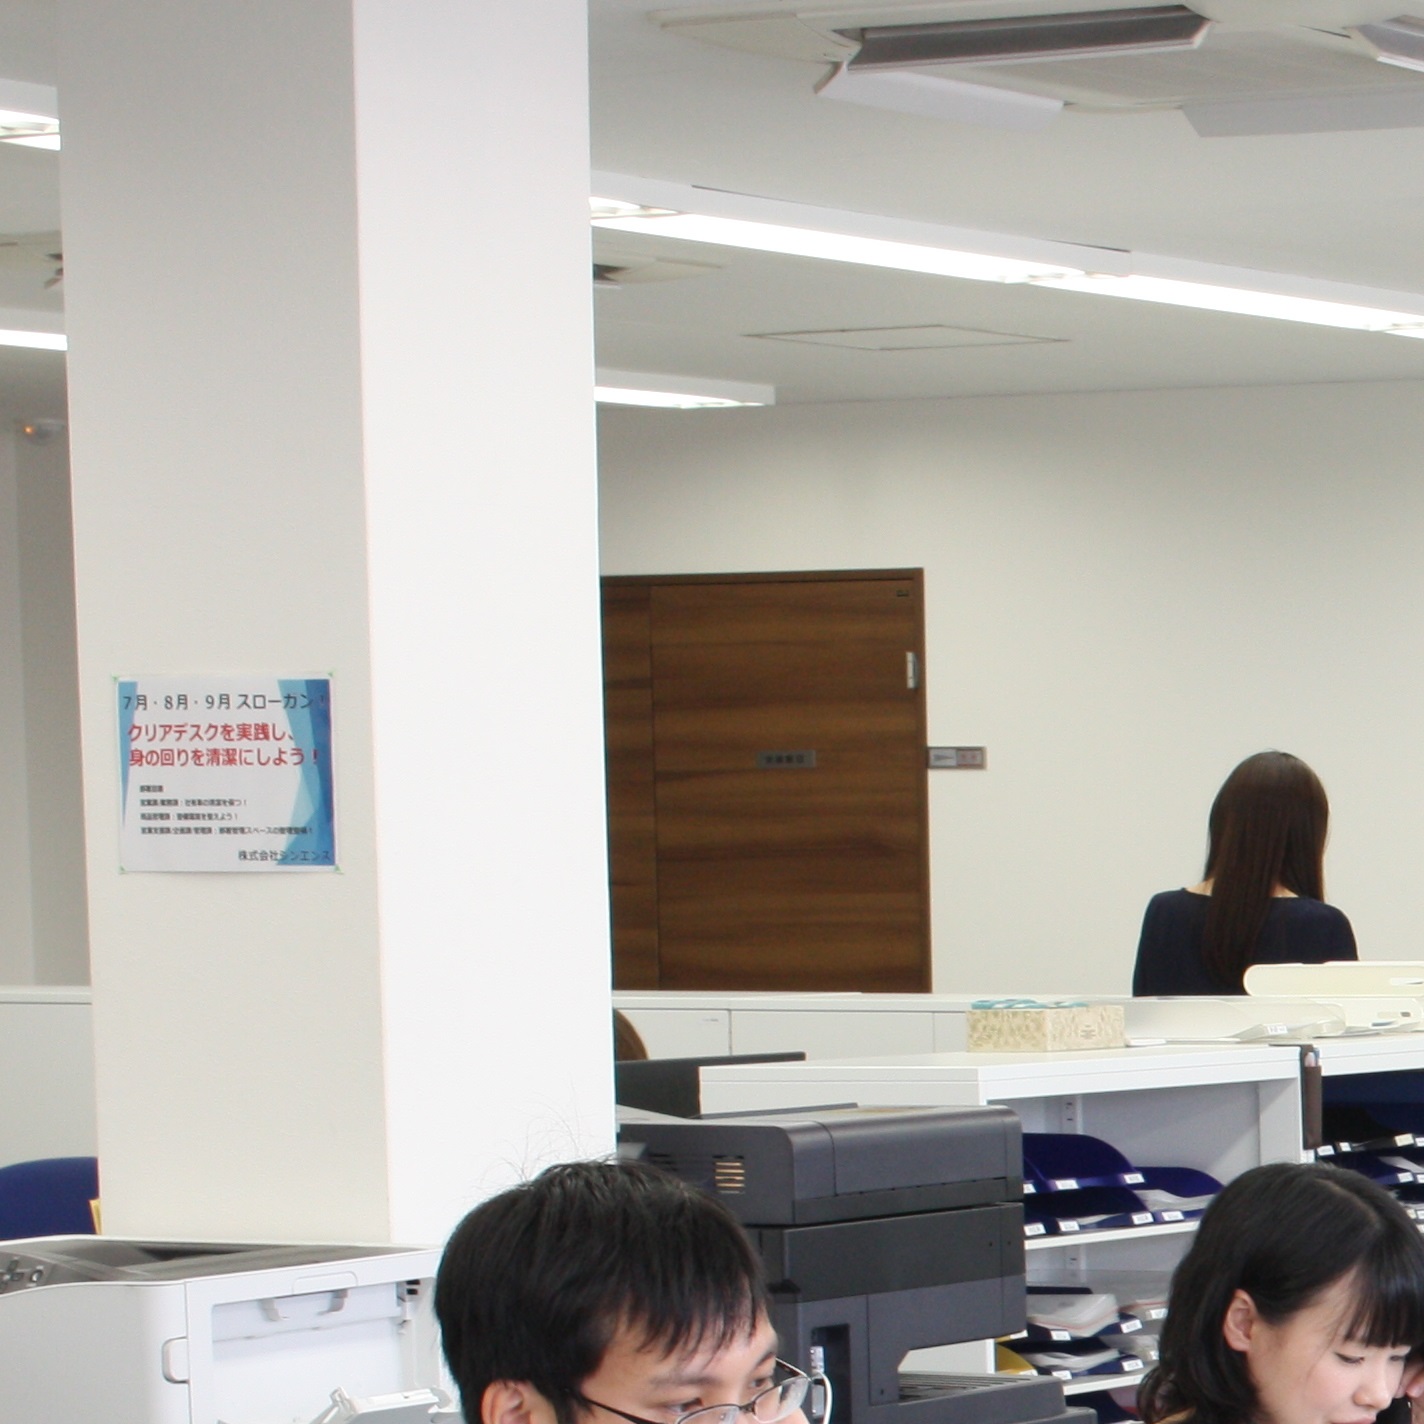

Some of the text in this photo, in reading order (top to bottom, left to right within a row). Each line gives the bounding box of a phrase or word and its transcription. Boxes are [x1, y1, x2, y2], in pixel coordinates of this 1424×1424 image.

[127, 722, 294, 742] クリアデスクを実践し、
[129, 747, 319, 767] 身の回りを清潔にしよう！
